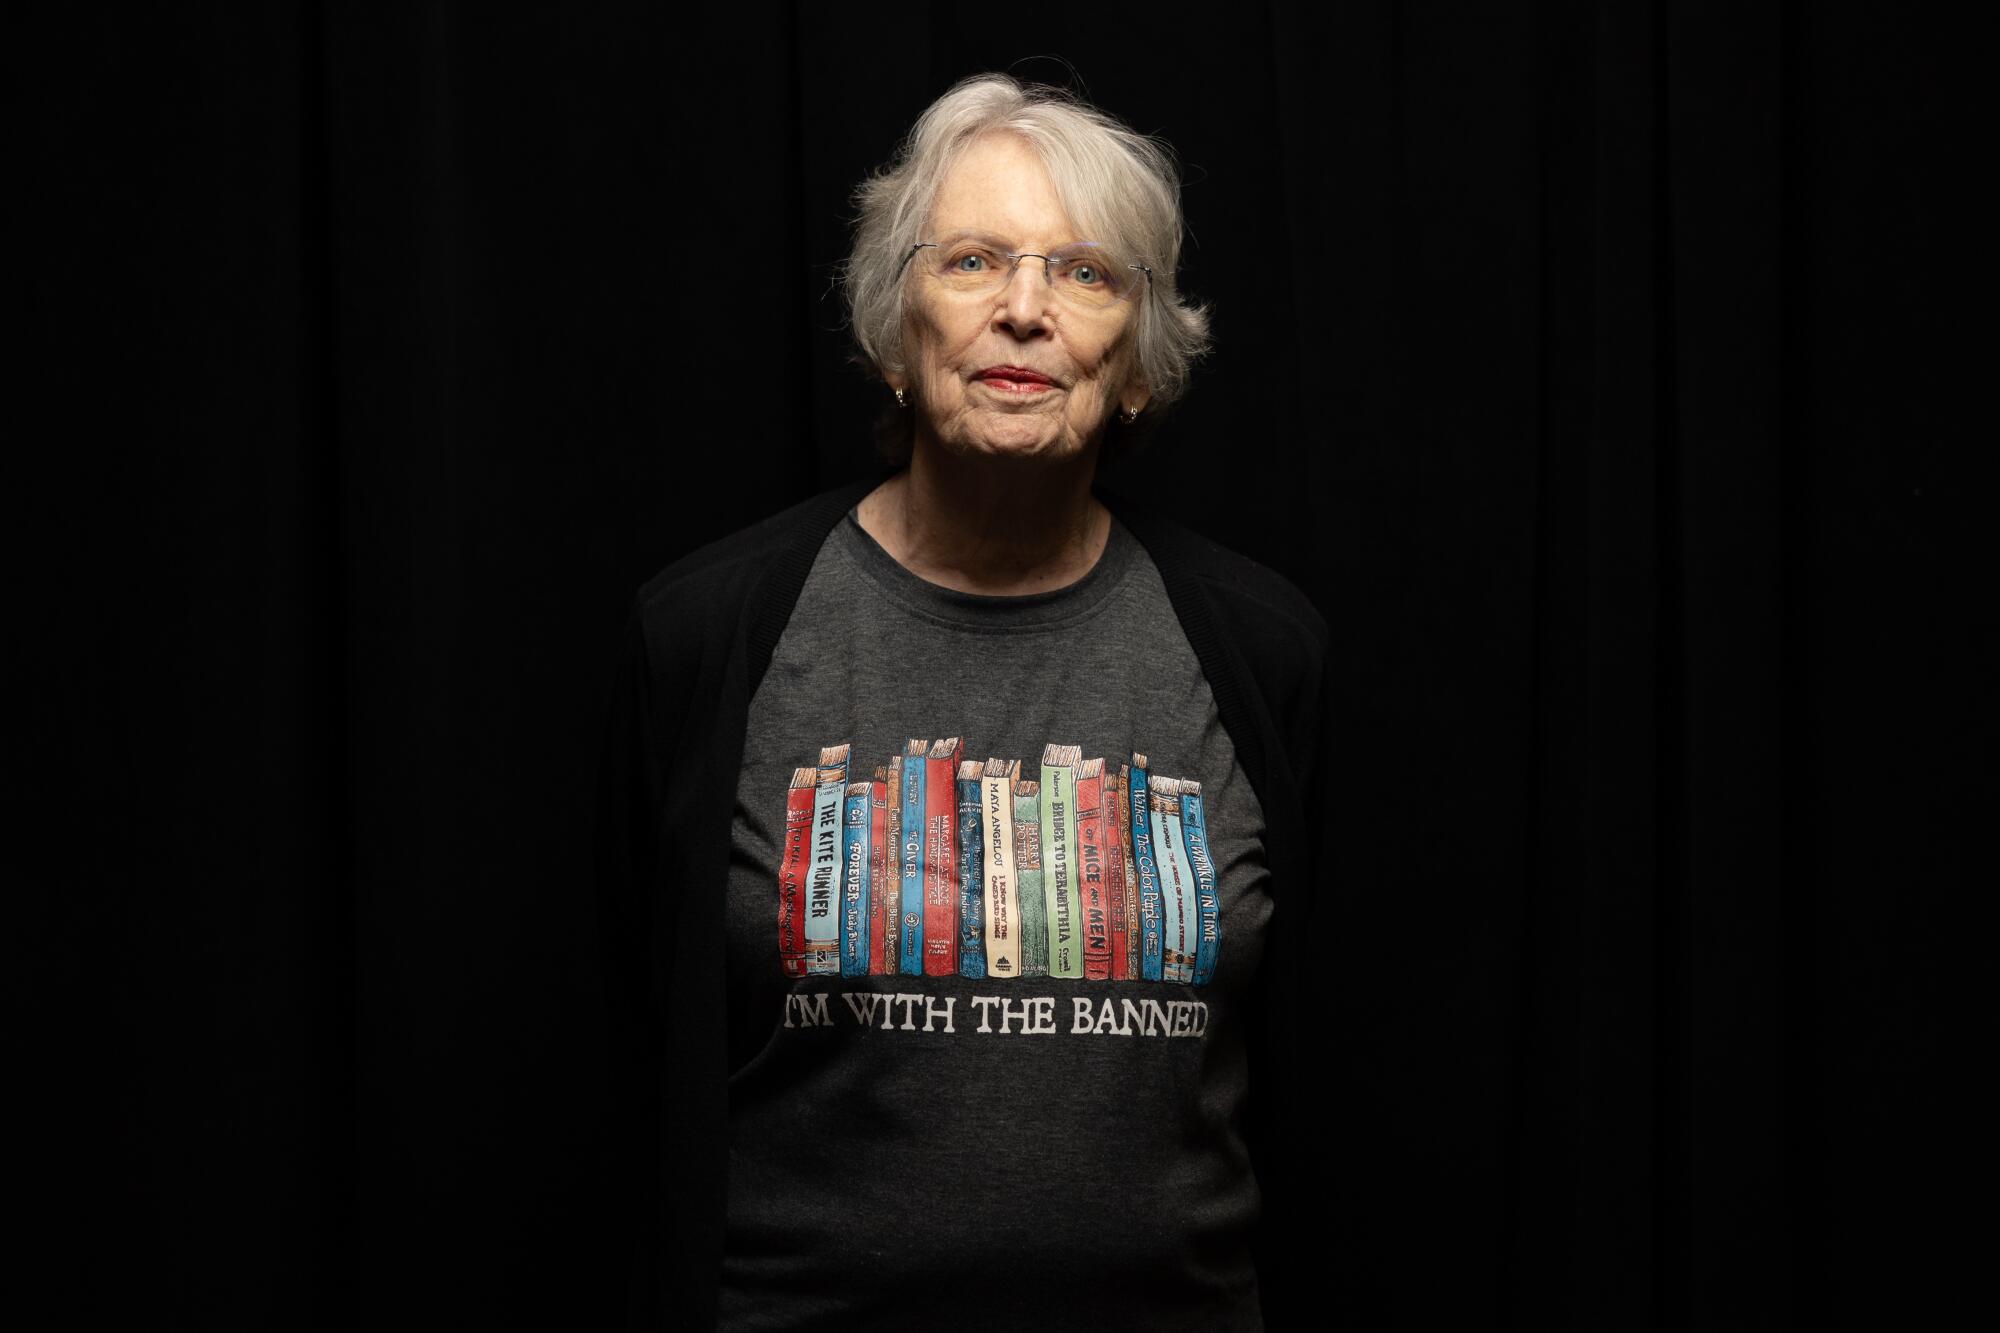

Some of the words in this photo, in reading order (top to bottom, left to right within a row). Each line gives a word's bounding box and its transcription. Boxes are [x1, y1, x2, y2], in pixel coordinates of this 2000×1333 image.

[820, 802, 836, 828] THE
[990, 783, 1000, 814] MAYA
[1133, 789, 1146, 829] Walker
[929, 815, 938, 835] THE
[1052, 801, 1066, 842] BRIDGE
[1188, 833, 1201, 842] A
[818, 830, 835, 864] KITE
[889, 827, 900, 862] Morrison
[940, 815, 950, 865] MARGARET
[991, 815, 1003, 866] ANGELOU
[1016, 825, 1027, 869] POTTER
[1028, 827, 1040, 865] HARRY
[1054, 844, 1066, 860] TO
[1136, 833, 1149, 855] The
[905, 842, 920, 878] GIVER
[1084, 844, 1102, 882] MICE
[1139, 856, 1157, 891] Color
[1190, 845, 1214, 891] WRINKLE
[812, 866, 833, 918] RUNNER
[991, 875, 999, 899] CAGED
[999, 882, 1007, 905] KNOW
[1090, 887, 1099, 906] AND
[1201, 895, 1215, 908] IN
[846, 909, 858, 931] Judy
[961, 891, 970, 919] Indian
[1142, 892, 1160, 929] Purple
[1088, 908, 1106, 949] MEN
[1203, 911, 1217, 943] TIME
[784, 993, 834, 1028] I'M
[842, 992, 957, 1033] WITH
[971, 996, 1057, 1034] THE
[1070, 997, 1208, 1038] BANNED
